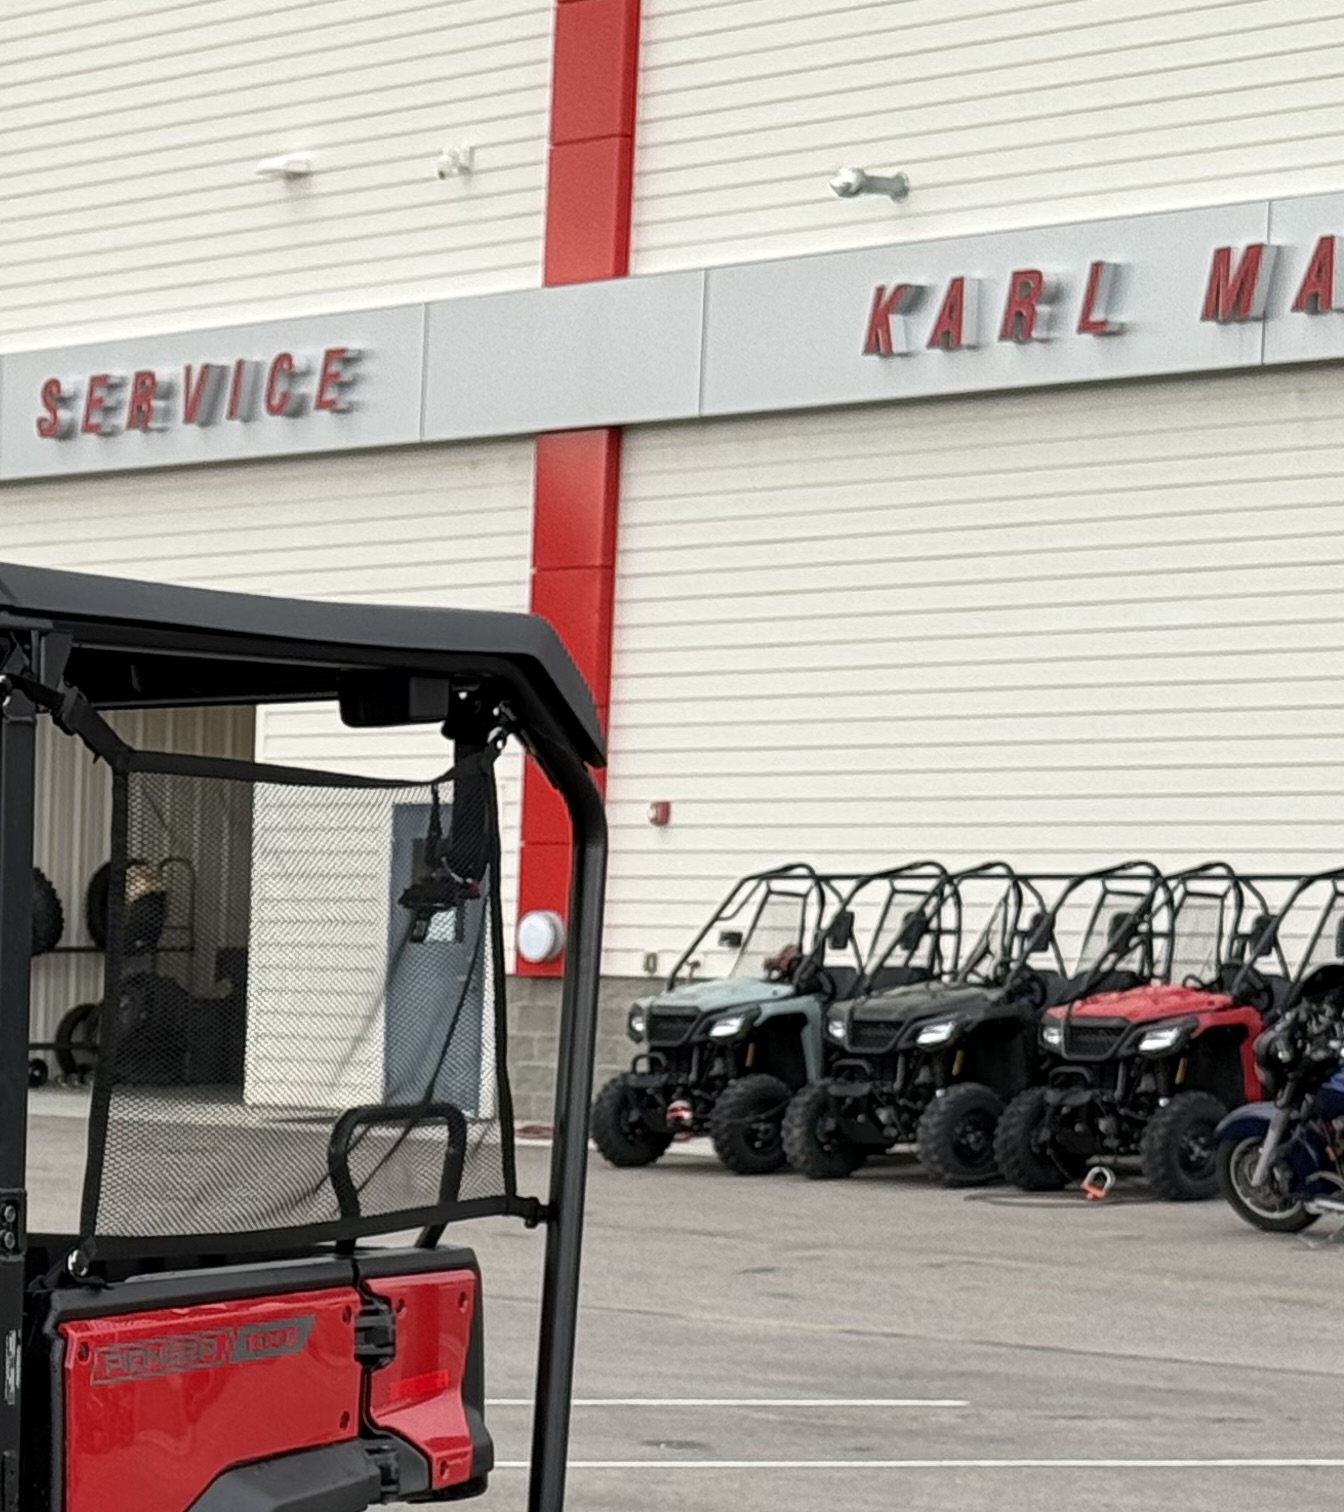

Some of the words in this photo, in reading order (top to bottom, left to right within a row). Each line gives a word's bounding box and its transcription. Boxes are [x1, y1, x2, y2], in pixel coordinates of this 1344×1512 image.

[862, 260, 1115, 357] KARL
[1200, 234, 1343, 323] MA
[35, 347, 357, 439] SERVICE
[101, 1333, 223, 1377] PIONEER
